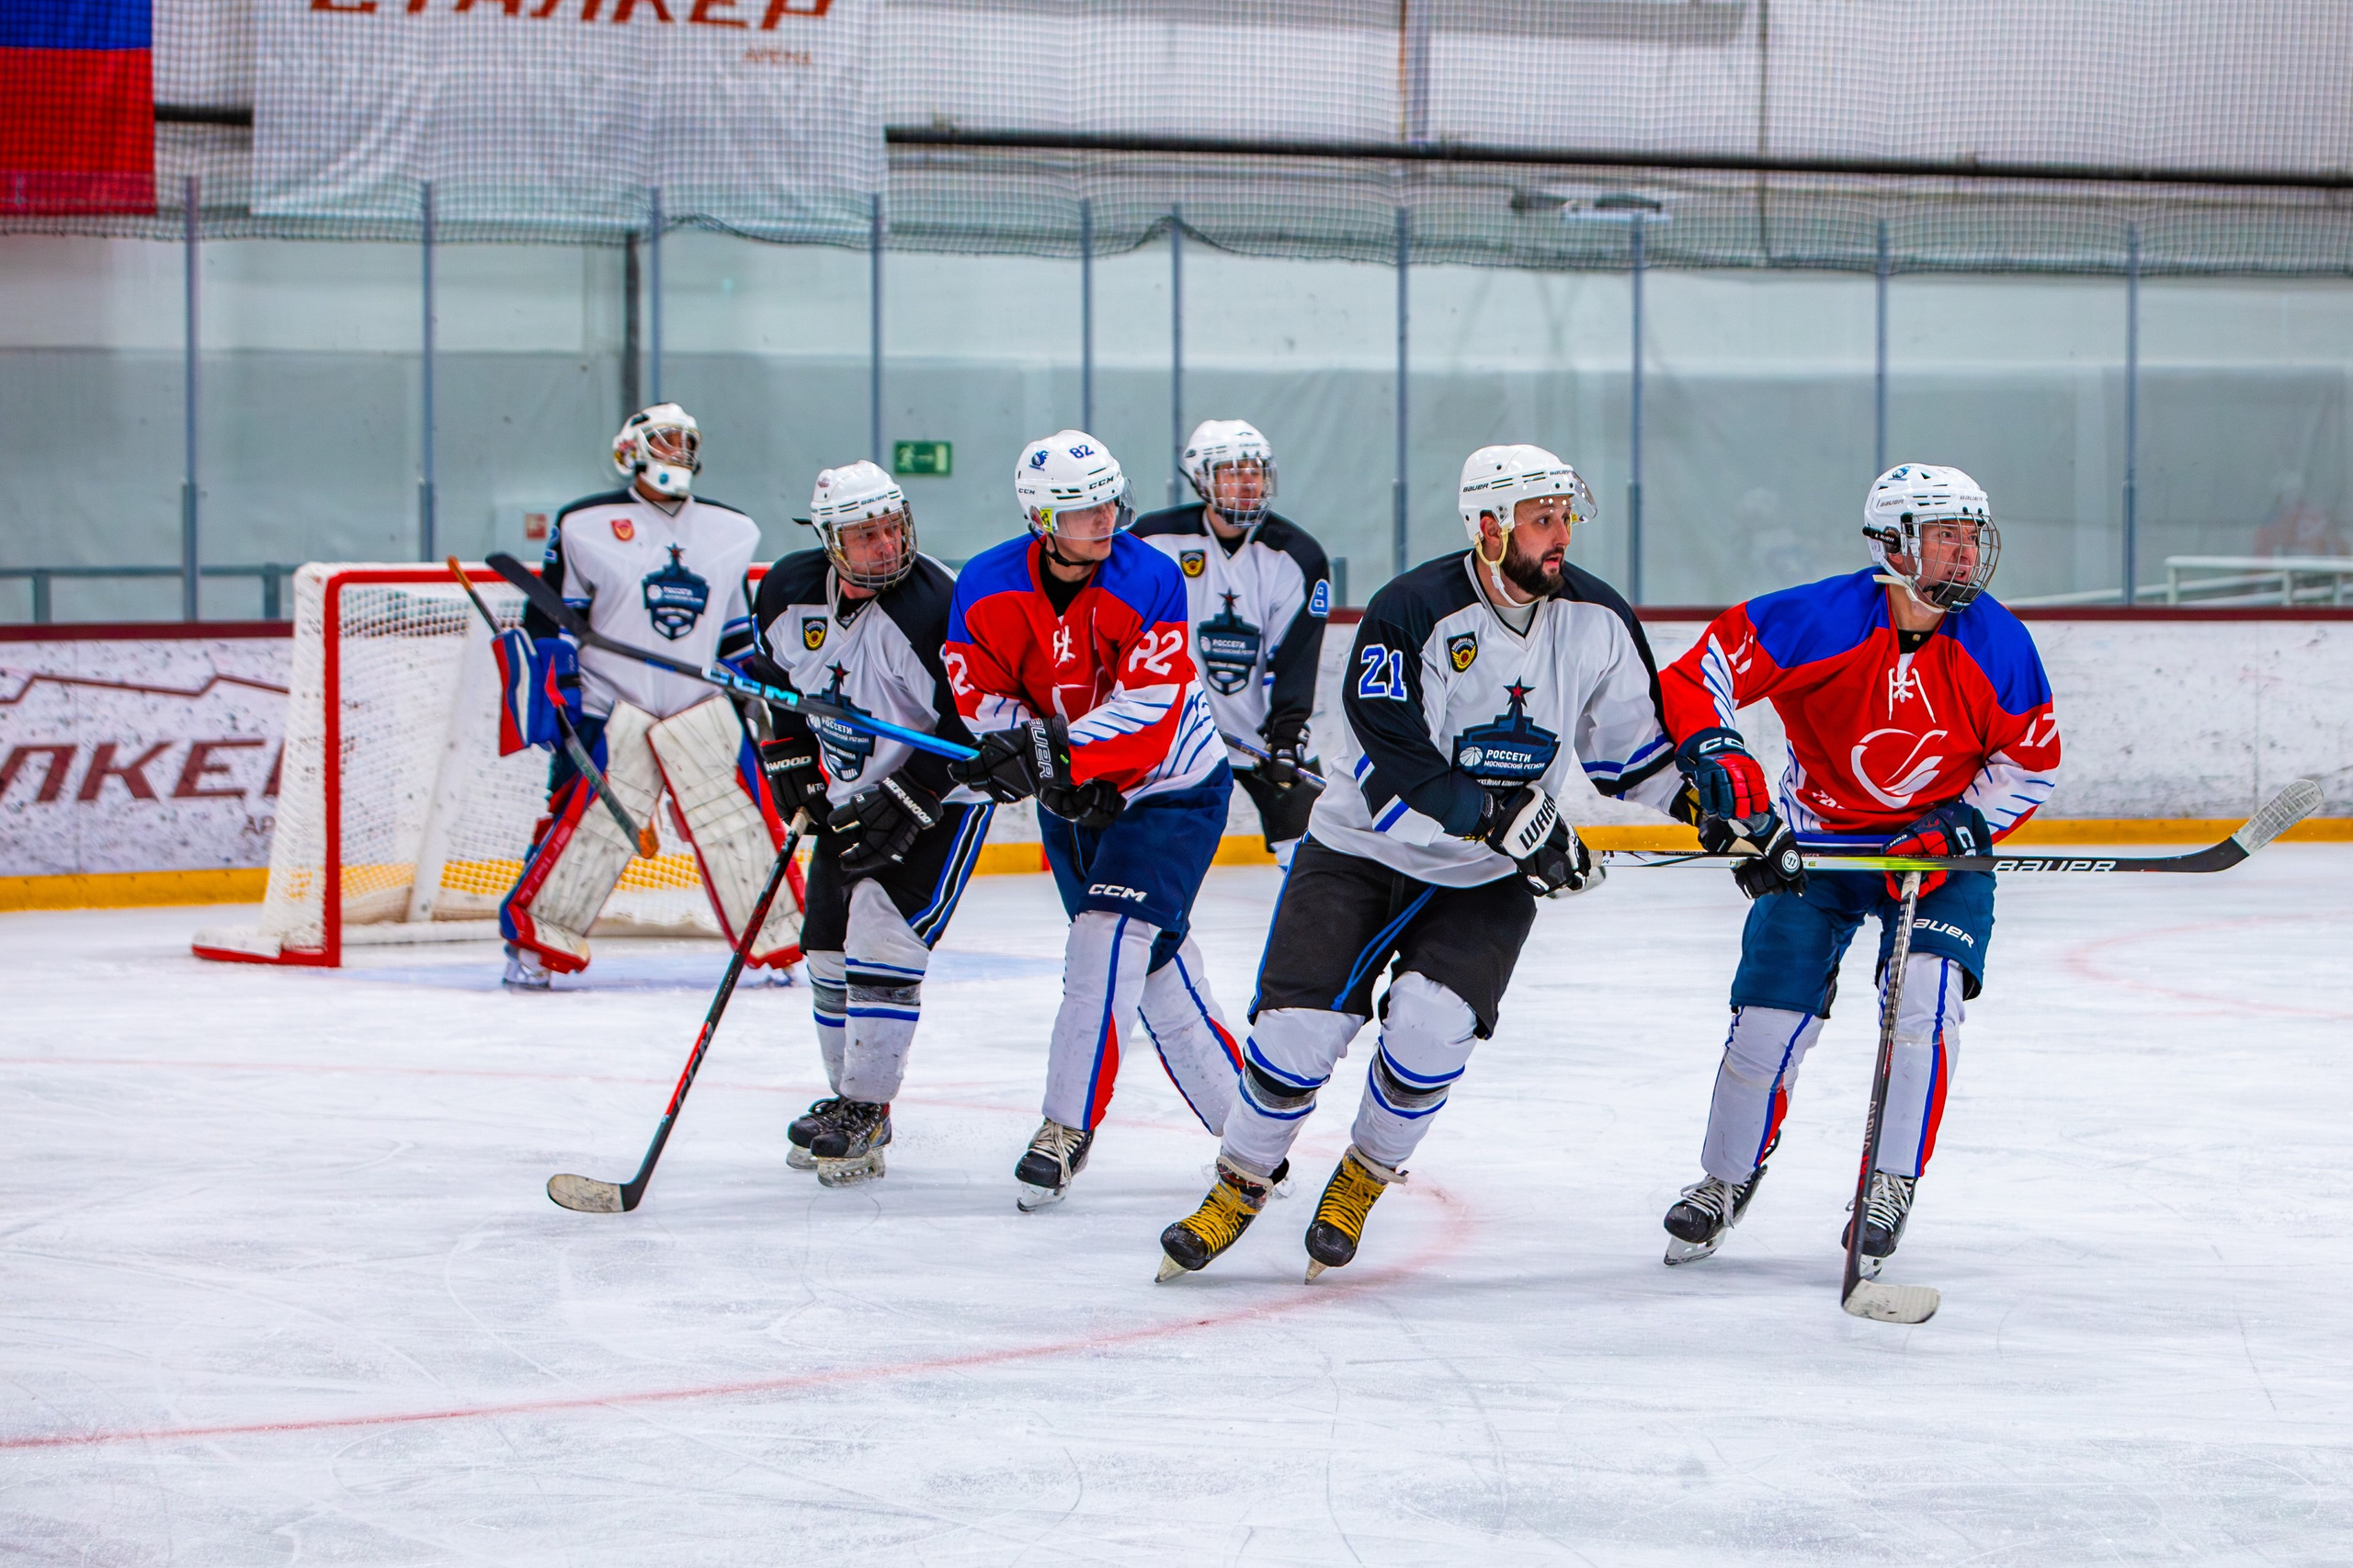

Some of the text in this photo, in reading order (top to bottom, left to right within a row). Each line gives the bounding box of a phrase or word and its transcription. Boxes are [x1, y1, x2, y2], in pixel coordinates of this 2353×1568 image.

[1069, 444, 1095, 459] 82
[1088, 475, 1115, 490] CCM
[1017, 487, 1035, 495] CCM
[1358, 643, 1407, 702] 21
[701, 665, 798, 707] CCM
[2018, 712, 2059, 747] 17
[1486, 749, 1532, 763] РОССЕТИ
[0, 741, 284, 801] ЛКЕ
[1483, 760, 1546, 770] МОСКОВСКИЙ РЕГИОН
[1992, 859, 2117, 872] BAUER
[1088, 883, 1147, 903] CCM
